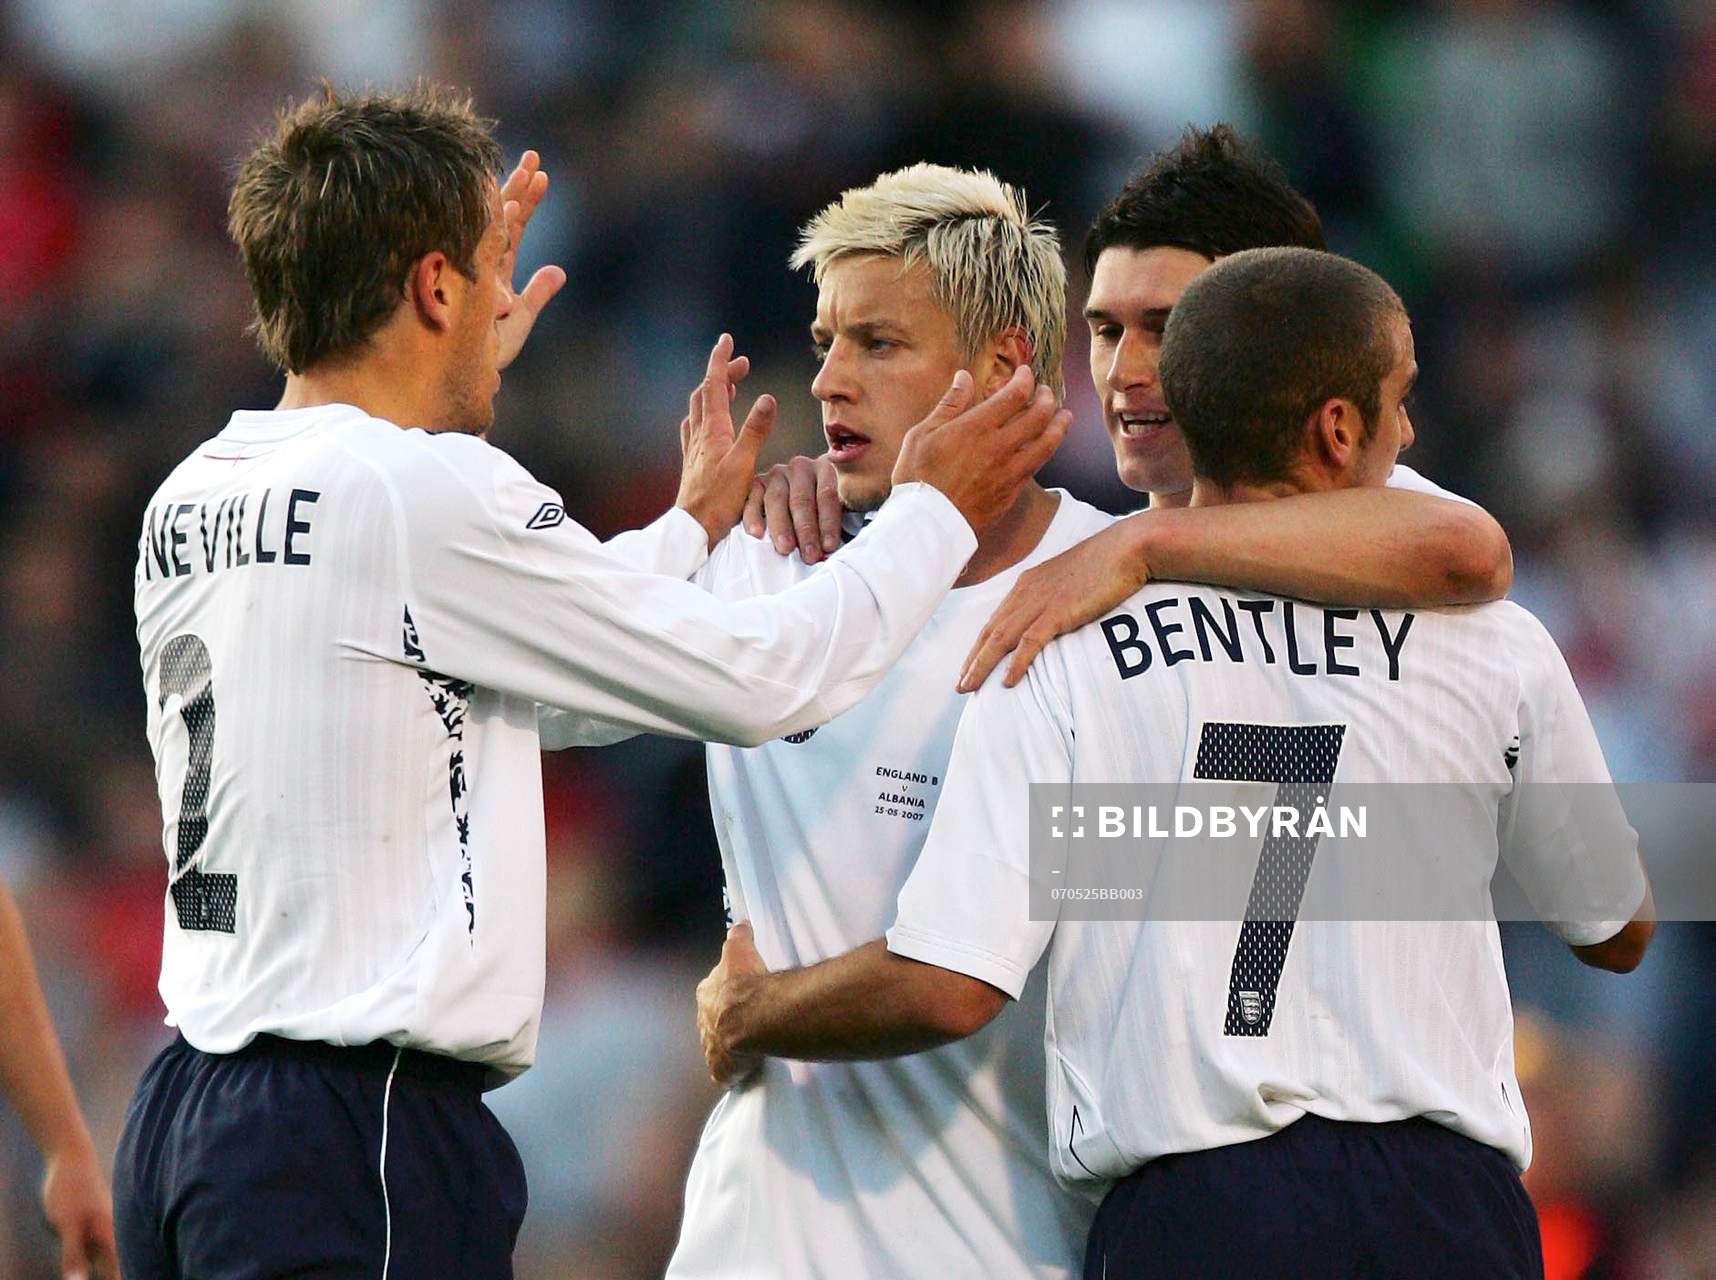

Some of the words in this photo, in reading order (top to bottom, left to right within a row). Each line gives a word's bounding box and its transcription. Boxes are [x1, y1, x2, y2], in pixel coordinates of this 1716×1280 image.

[145, 489, 320, 581] NEVILLE
[1100, 597, 1415, 681] BENTLEY
[159, 634, 238, 933] 2
[876, 767, 927, 784] ENGLAND
[932, 776, 938, 786] B
[878, 792, 925, 809] ALBANIA
[1193, 722, 1346, 1037] 7
